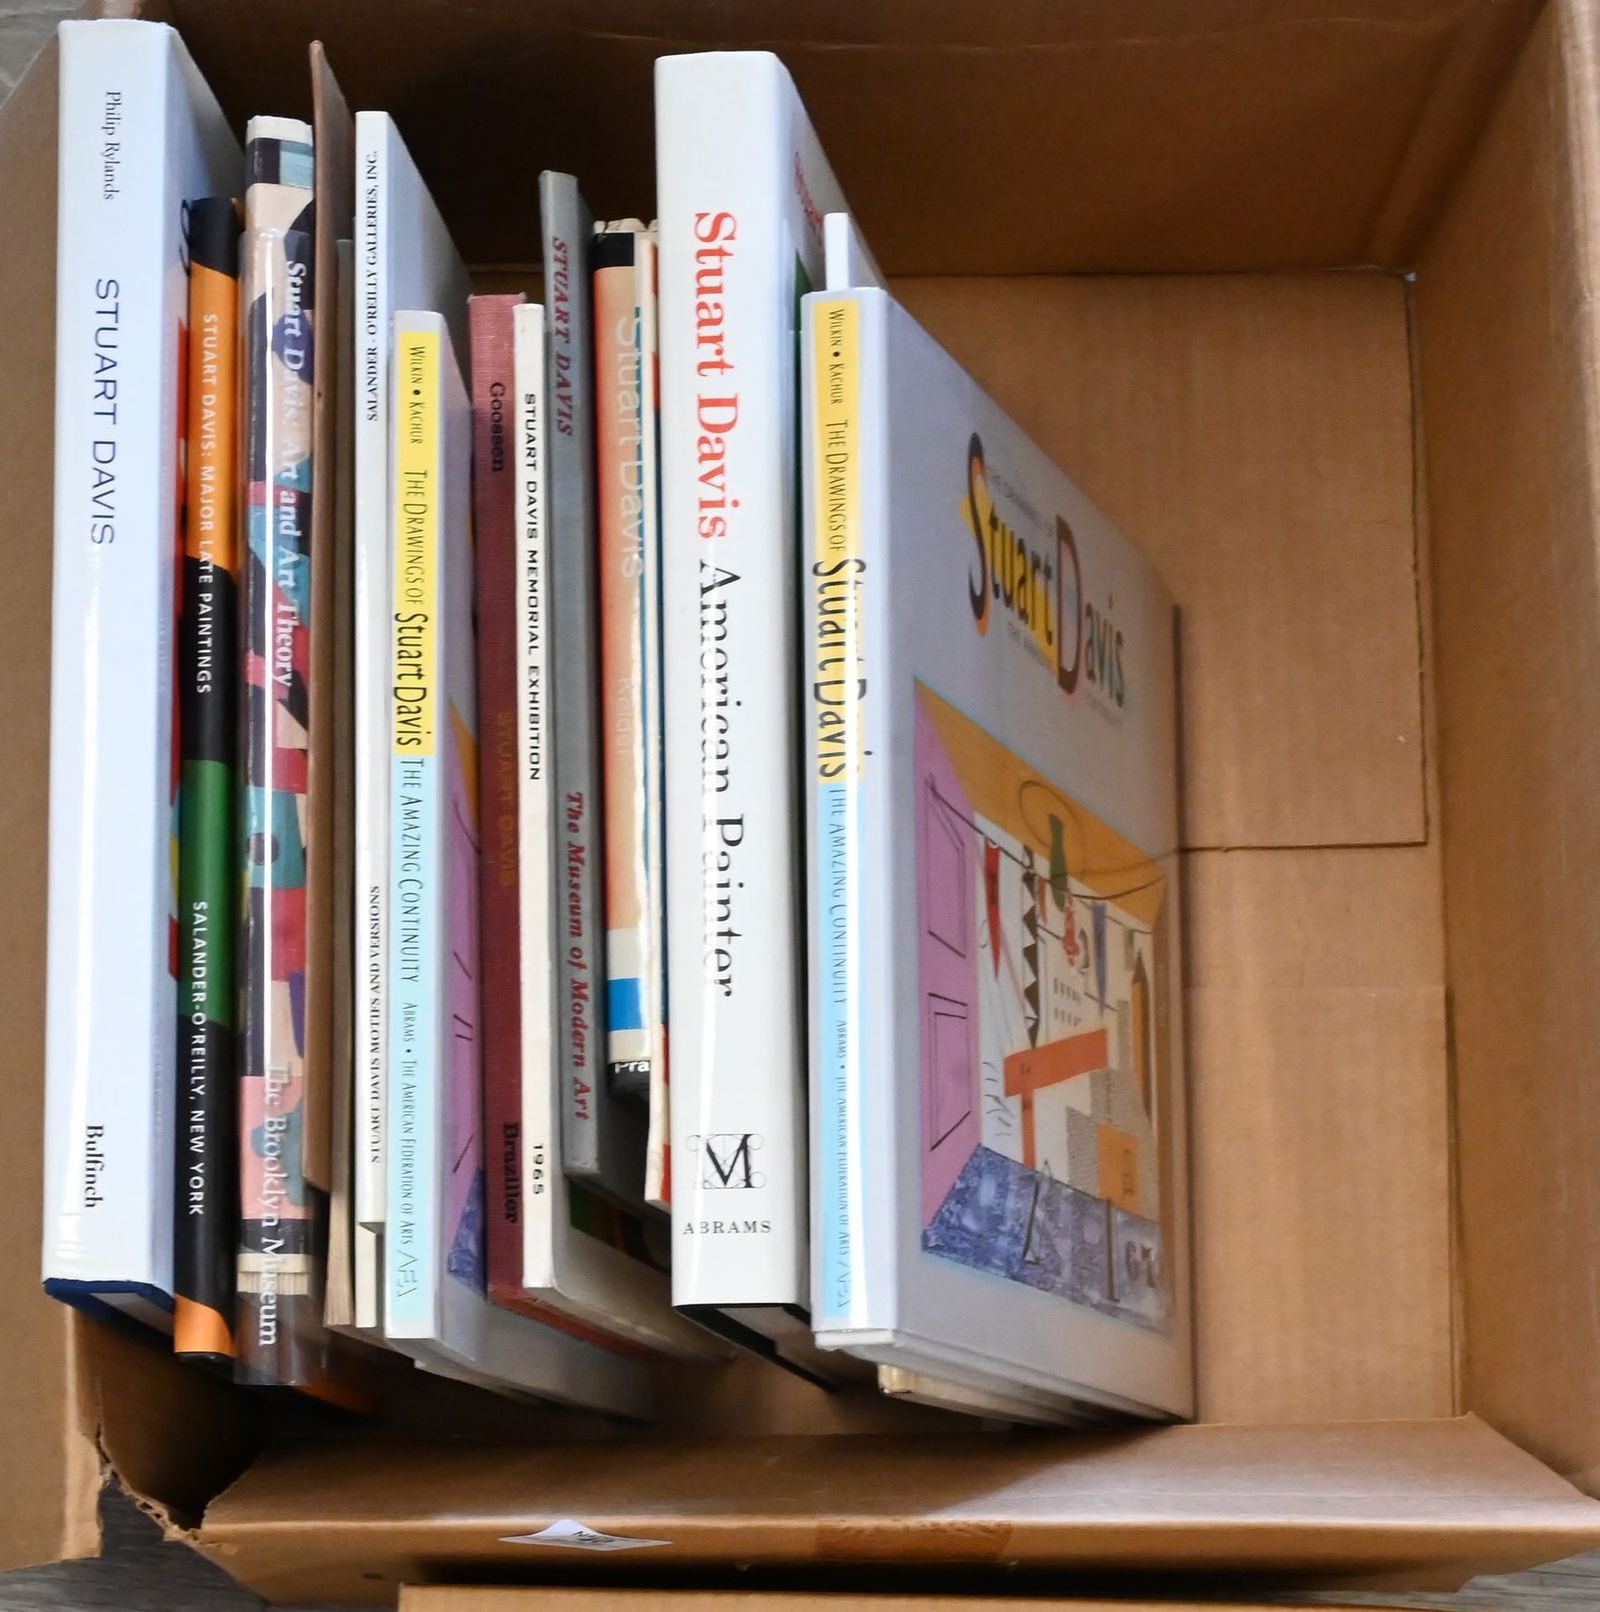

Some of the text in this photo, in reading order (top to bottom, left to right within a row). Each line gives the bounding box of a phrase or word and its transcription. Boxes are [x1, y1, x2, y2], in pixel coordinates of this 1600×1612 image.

[101, 91, 121, 200] Philip Rylands
[365, 150, 378, 422] SALANDER O'REILLY GALLERIES, INC.
[552, 236, 574, 436] STUART DAVIS
[90, 278, 119, 545] STUART DAVIS
[195, 313, 218, 693] STUART DAVIS: MAJOR LATE PAINTINGS
[272, 261, 306, 686] Stuart Davis: Art and Art Theory
[488, 382, 506, 472] Goossen
[614, 316, 648, 580] Stuart Davis
[394, 612, 428, 680] Stuart
[524, 393, 542, 781] STUART DAVIS MEMORIAL EXHIBITION
[695, 211, 745, 997] Stuart Davis American Painter
[813, 558, 866, 671] Stuart
[968, 432, 1124, 708] Stuart Davis
[394, 686, 431, 747] Davis
[497, 711, 517, 887] STUART DAVIS
[815, 678, 873, 776] Davis
[187, 901, 208, 1216] SALANDER-O'REILLY, NEW YORK
[368, 886, 382, 1164] STUART DAVIS MOTIFS AND VERSIONS
[566, 792, 593, 1119] The Museum of Modern Art
[82, 1124, 105, 1208] Bulfinch
[257, 1063, 289, 1346] The Brooklyn Museum
[501, 1122, 520, 1224] Braziller
[532, 1143, 545, 1195] 1965
[683, 1220, 772, 1235] ABRAMS
